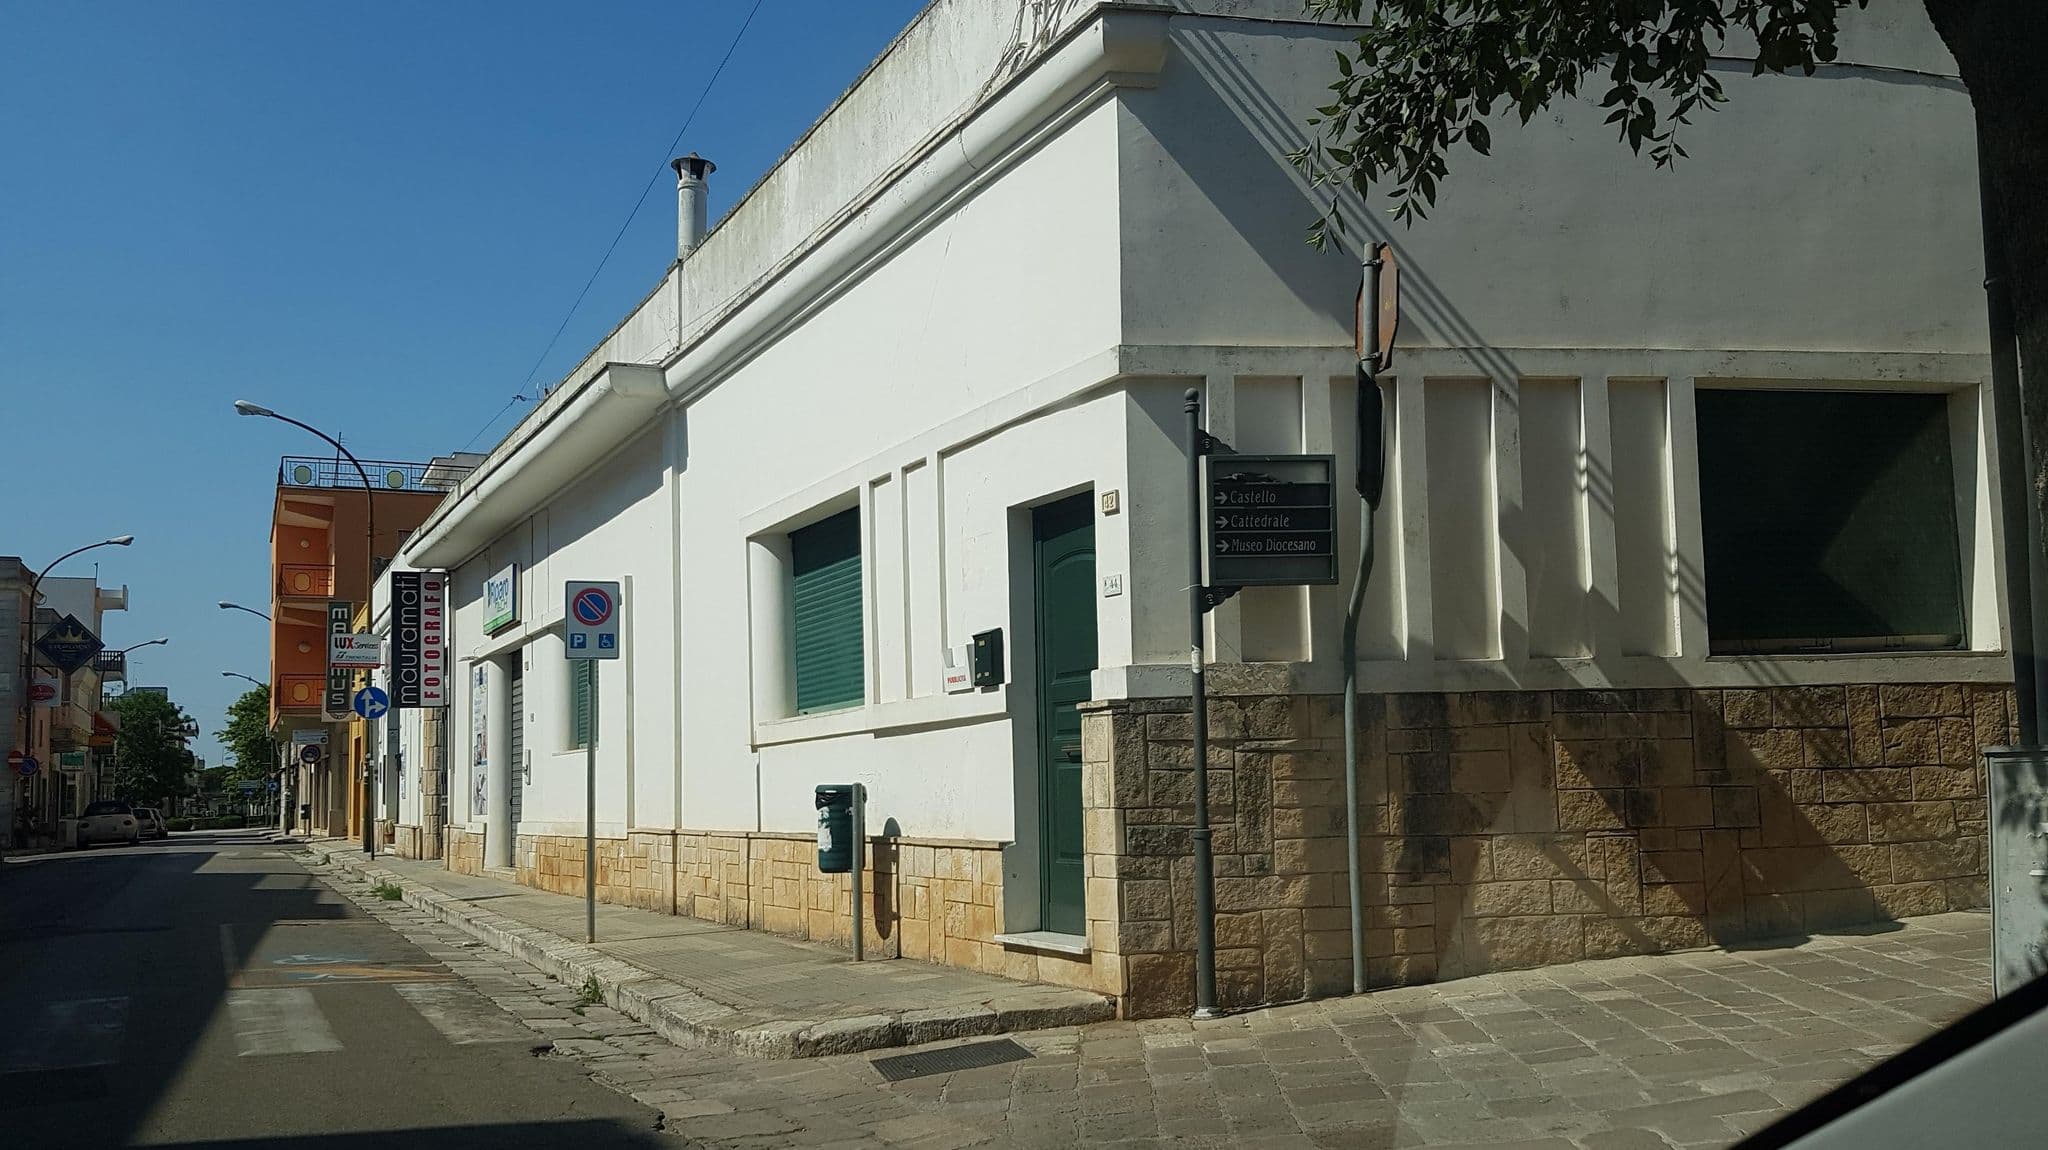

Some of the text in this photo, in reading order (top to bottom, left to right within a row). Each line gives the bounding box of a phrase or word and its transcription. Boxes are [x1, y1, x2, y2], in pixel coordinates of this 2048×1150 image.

[1230, 490, 1277, 504] Castello
[1231, 513, 1290, 528] Cattedrale
[1231, 538, 1317, 552] Museo Diocesano
[335, 637, 354, 649] LUX
[395, 575, 418, 705] mauramati
[425, 581, 441, 700] FOTOGRAFO
[574, 635, 584, 647] P
